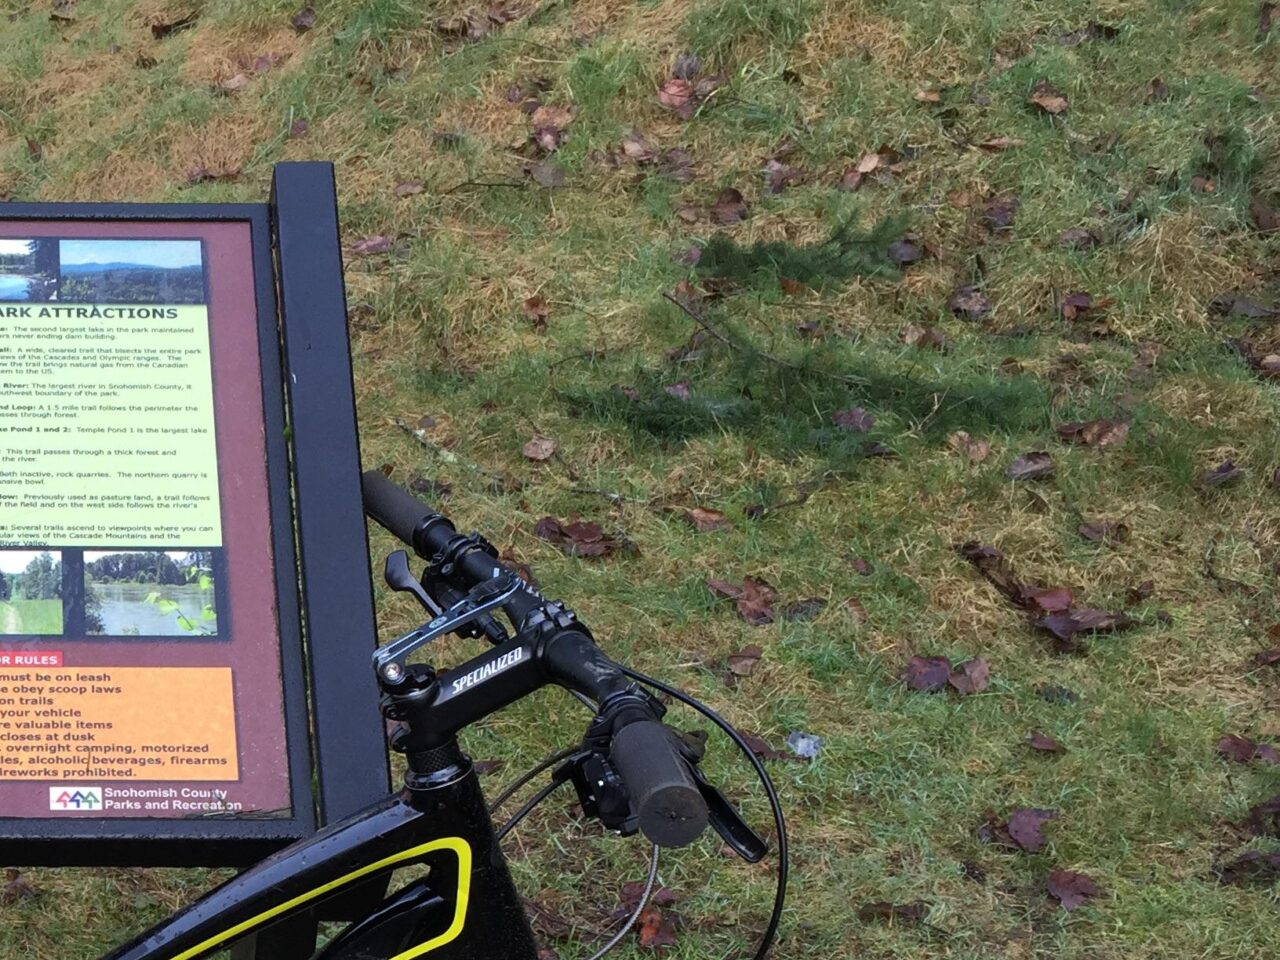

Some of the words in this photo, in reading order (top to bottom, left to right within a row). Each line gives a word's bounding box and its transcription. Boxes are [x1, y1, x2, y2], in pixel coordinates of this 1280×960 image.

[38, 306, 178, 318] ATTRACTIONS
[76, 425, 105, 434] Temple
[160, 426, 188, 434] largest
[14, 655, 58, 664] RULES
[452, 646, 522, 695] SPECIALIZED
[35, 672, 51, 681] be
[75, 672, 111, 681] leash
[11, 683, 44, 695] obey
[48, 686, 87, 695] scoop
[91, 683, 122, 693] laws
[18, 695, 54, 704] trails
[0, 709, 30, 719] your
[33, 707, 81, 717] vehicle
[14, 719, 71, 728] valuable
[75, 719, 113, 728] items
[0, 731, 41, 741] closes
[45, 731, 59, 741] at
[62, 731, 95, 741] dusk
[5, 742, 71, 754] overnight
[74, 742, 136, 754] camping,
[140, 742, 209, 752] motorized
[27, 754, 91, 764] alcoholic
[91, 754, 165, 766] beverages,
[169, 754, 227, 764] firearms
[62, 766, 136, 778] prohibited.
[104, 786, 177, 797] Snohomish
[104, 798, 141, 809] Parks
[144, 798, 169, 809] and
